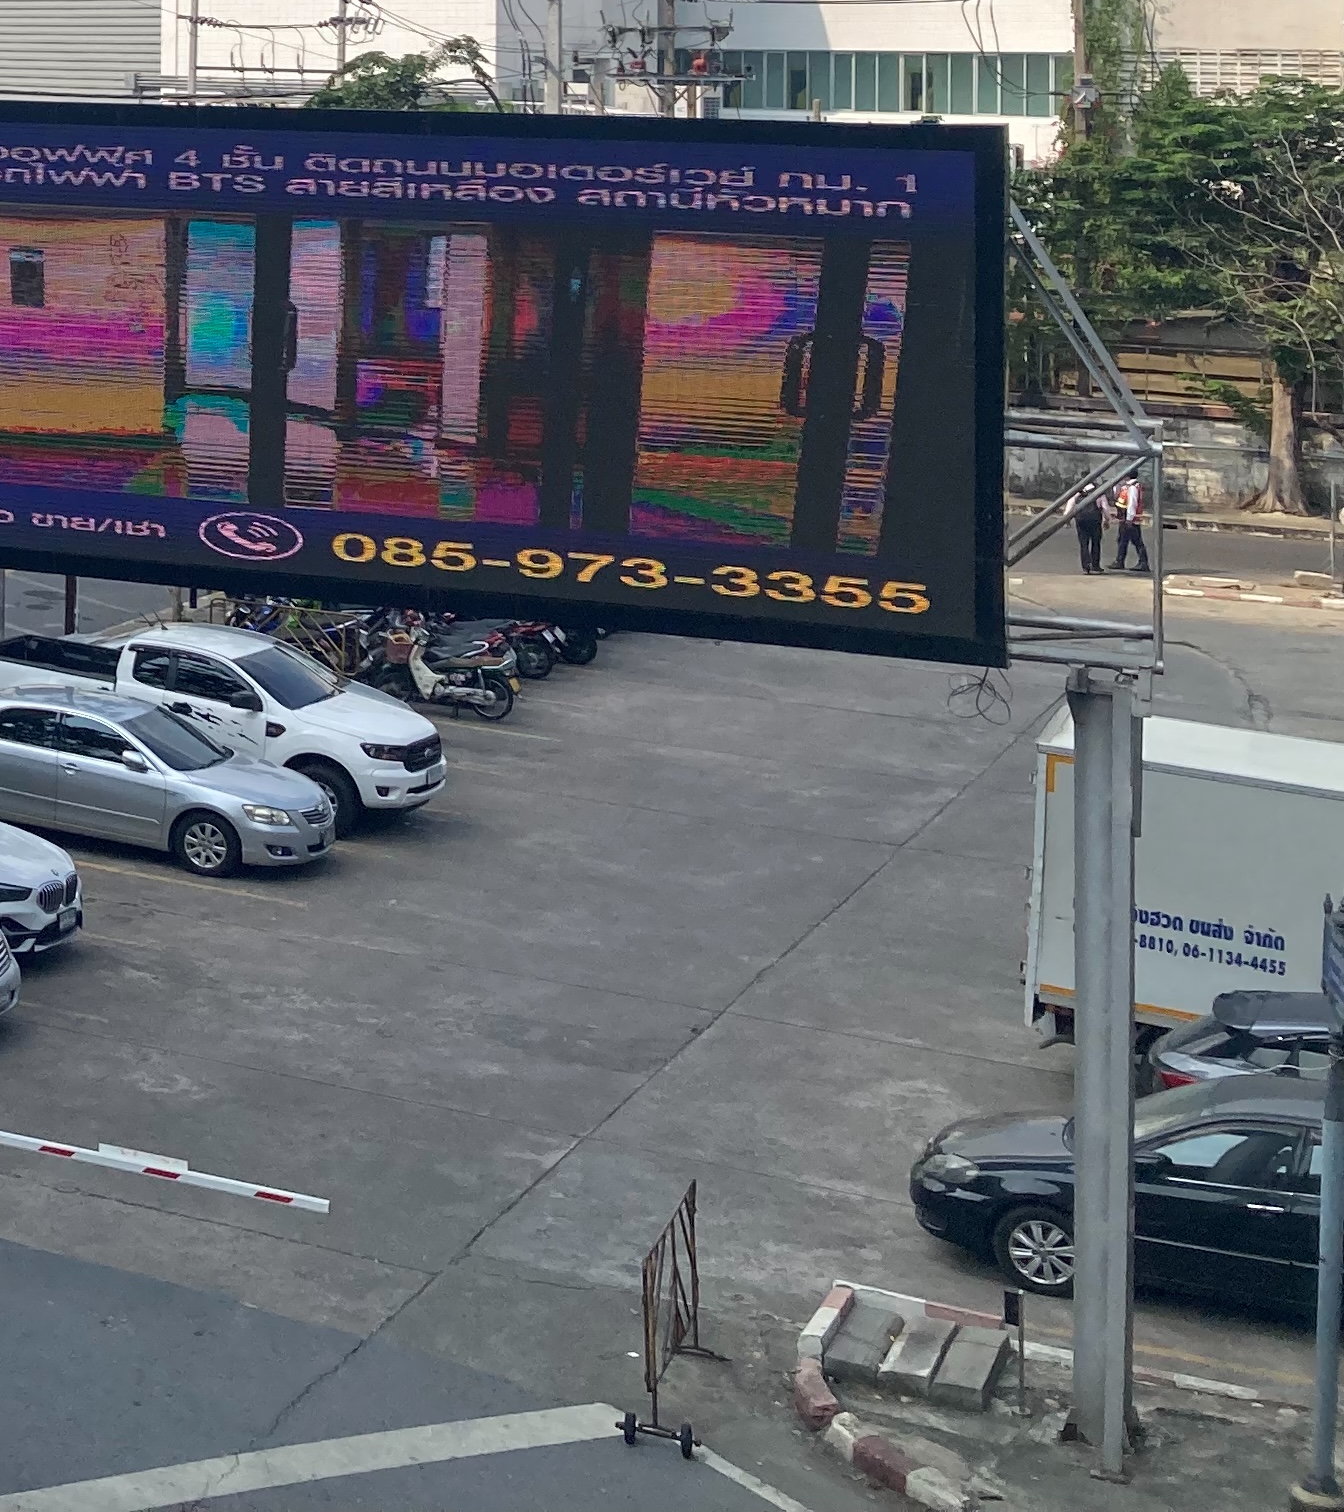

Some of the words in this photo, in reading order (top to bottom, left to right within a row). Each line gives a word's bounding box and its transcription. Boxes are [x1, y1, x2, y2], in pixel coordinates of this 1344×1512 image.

[168, 171, 266, 193] BTS
[173, 149, 201, 168] 4
[221, 144, 284, 171] ชั้น
[778, 172, 869, 192] กม.
[895, 173, 917, 194] 1
[332, 533, 932, 616] 085-973-3355
[1182, 942, 1287, 976] 06-1134-4455
